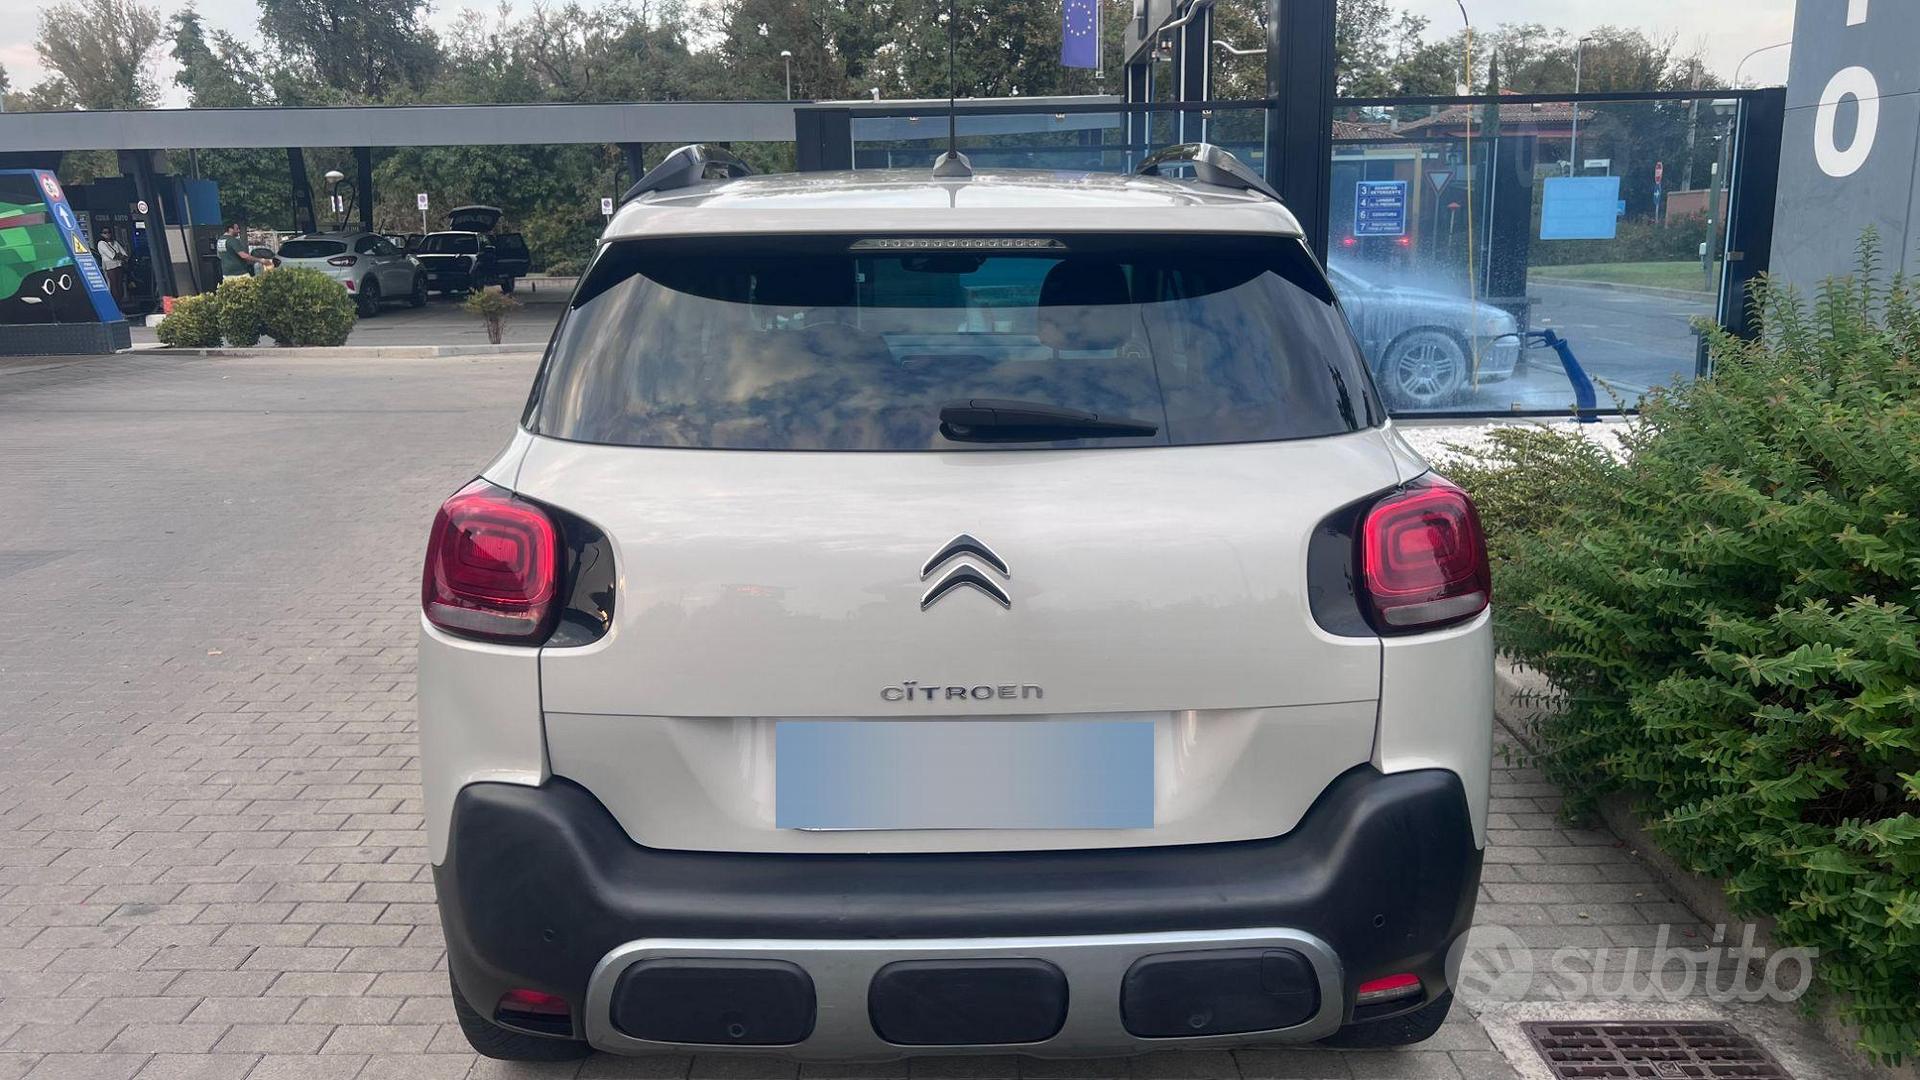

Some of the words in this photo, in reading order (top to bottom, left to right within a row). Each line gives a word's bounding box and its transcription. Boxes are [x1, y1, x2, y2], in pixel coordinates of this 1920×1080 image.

[1361, 186, 1367, 195] 3
[1360, 198, 1367, 206] 4
[1360, 210, 1366, 219] 6
[1360, 223, 1366, 231] 7
